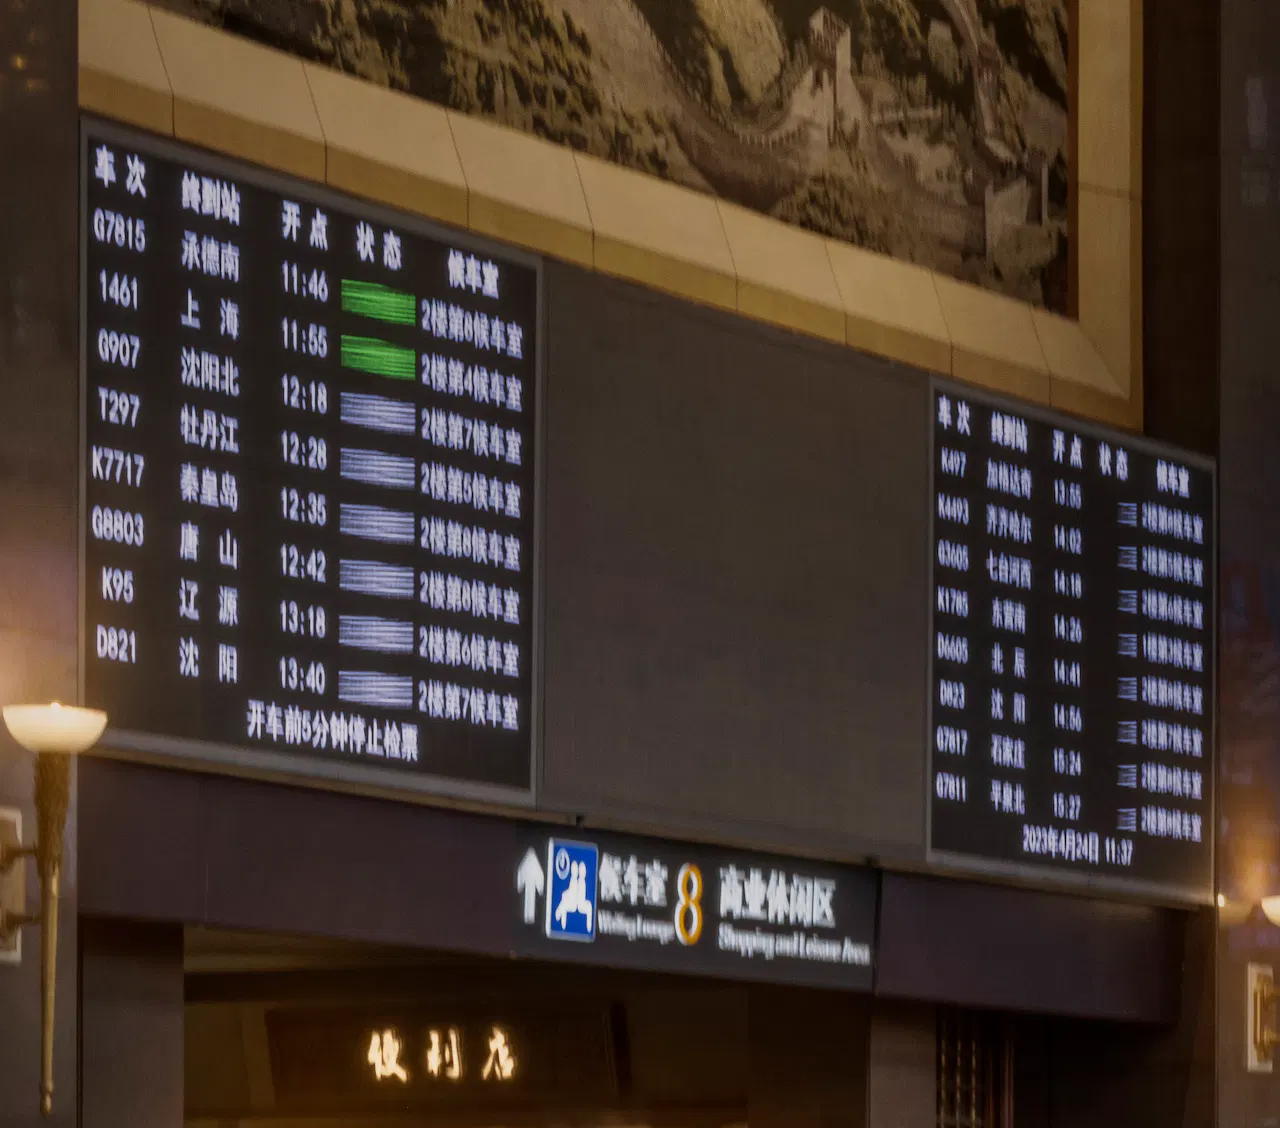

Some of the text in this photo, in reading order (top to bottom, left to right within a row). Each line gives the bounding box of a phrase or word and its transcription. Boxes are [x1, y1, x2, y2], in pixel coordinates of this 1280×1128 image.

[93, 207, 146, 253] G7815
[181, 230, 240, 283] 承德南
[281, 260, 329, 303] 11:46
[94, 143, 500, 300] 车次 终到站 开点 状态 候车室
[99, 269, 138, 311] 1461
[180, 288, 240, 340] 上海
[281, 316, 328, 359] 11:55
[97, 327, 141, 369] G907
[180, 346, 240, 397] 沈阳北
[281, 373, 328, 415] 12:18
[98, 386, 141, 428] T297
[180, 403, 240, 454] 牡丹江
[281, 430, 328, 471] 12:28
[91, 444, 145, 488] K7717
[179, 462, 239, 513] 秦皇岛
[280, 486, 327, 527] 12:35
[91, 504, 145, 547] G8803
[179, 520, 238, 570] 唐山
[280, 543, 327, 584] 12:42
[101, 565, 134, 604] K95
[178, 577, 239, 627] 辽源
[279, 599, 326, 639] 13:18
[95, 623, 137, 664] D821
[178, 636, 238, 684] 沈阳
[279, 656, 326, 695] 13:40
[1022, 823, 1100, 865] 2023年4月24日
[674, 862, 704, 946] 8
[718, 863, 837, 929] 商业休闲区
[718, 922, 775, 961] Shopping
[844, 936, 871, 967] Area
